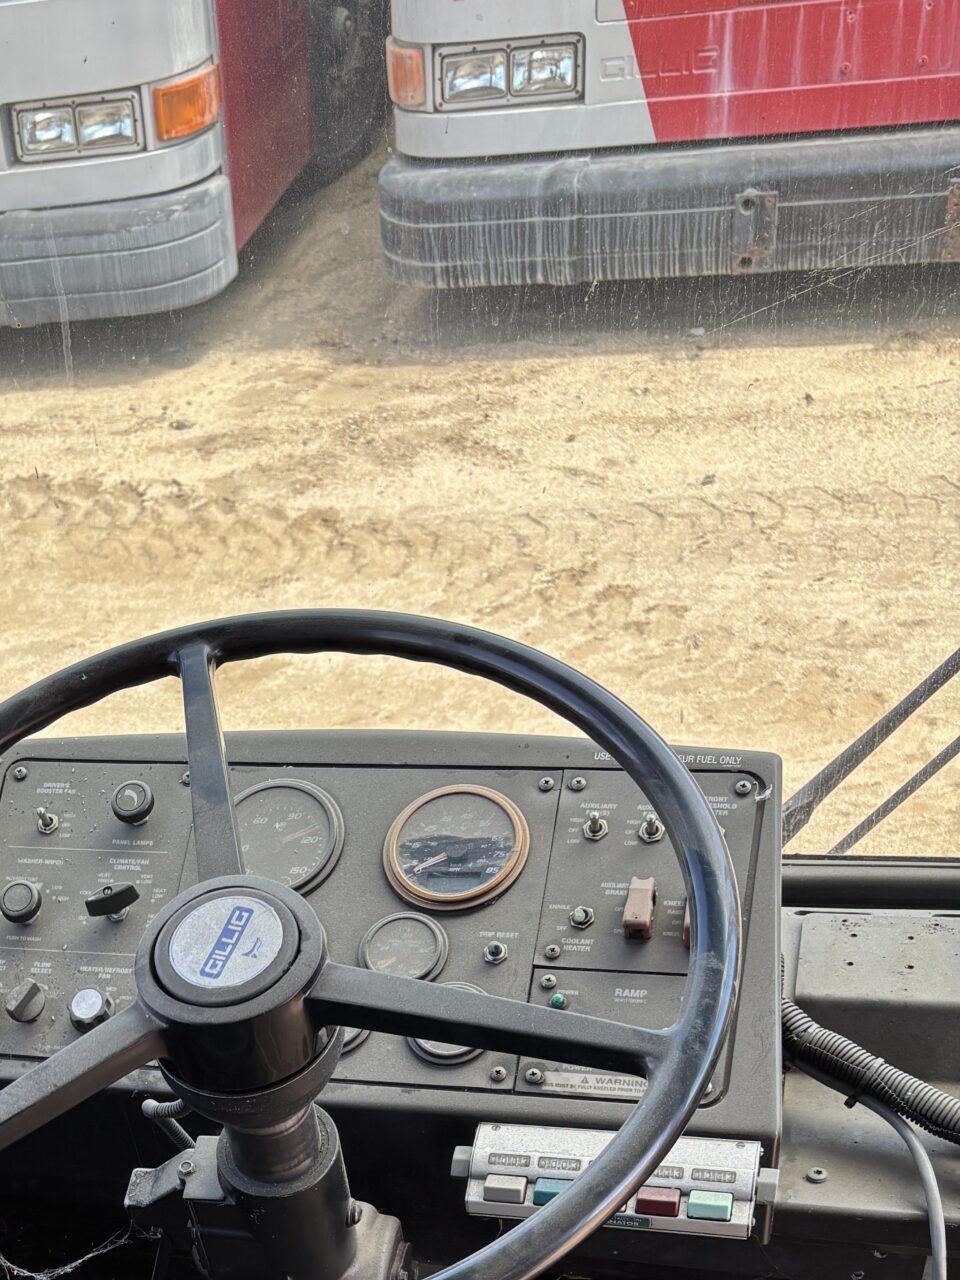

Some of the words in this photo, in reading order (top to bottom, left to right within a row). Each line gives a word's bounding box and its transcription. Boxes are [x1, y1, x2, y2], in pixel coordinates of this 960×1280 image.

[600, 45, 718, 82] GILLIG
[594, 752, 611, 760] USE
[696, 755, 717, 764] FUEL
[720, 756, 742, 765] ONLY
[253, 817, 269, 825] 60
[289, 866, 308, 874] 150
[203, 909, 251, 976] GILLIG
[561, 937, 594, 945] COOLANT
[614, 988, 648, 998] RAMP
